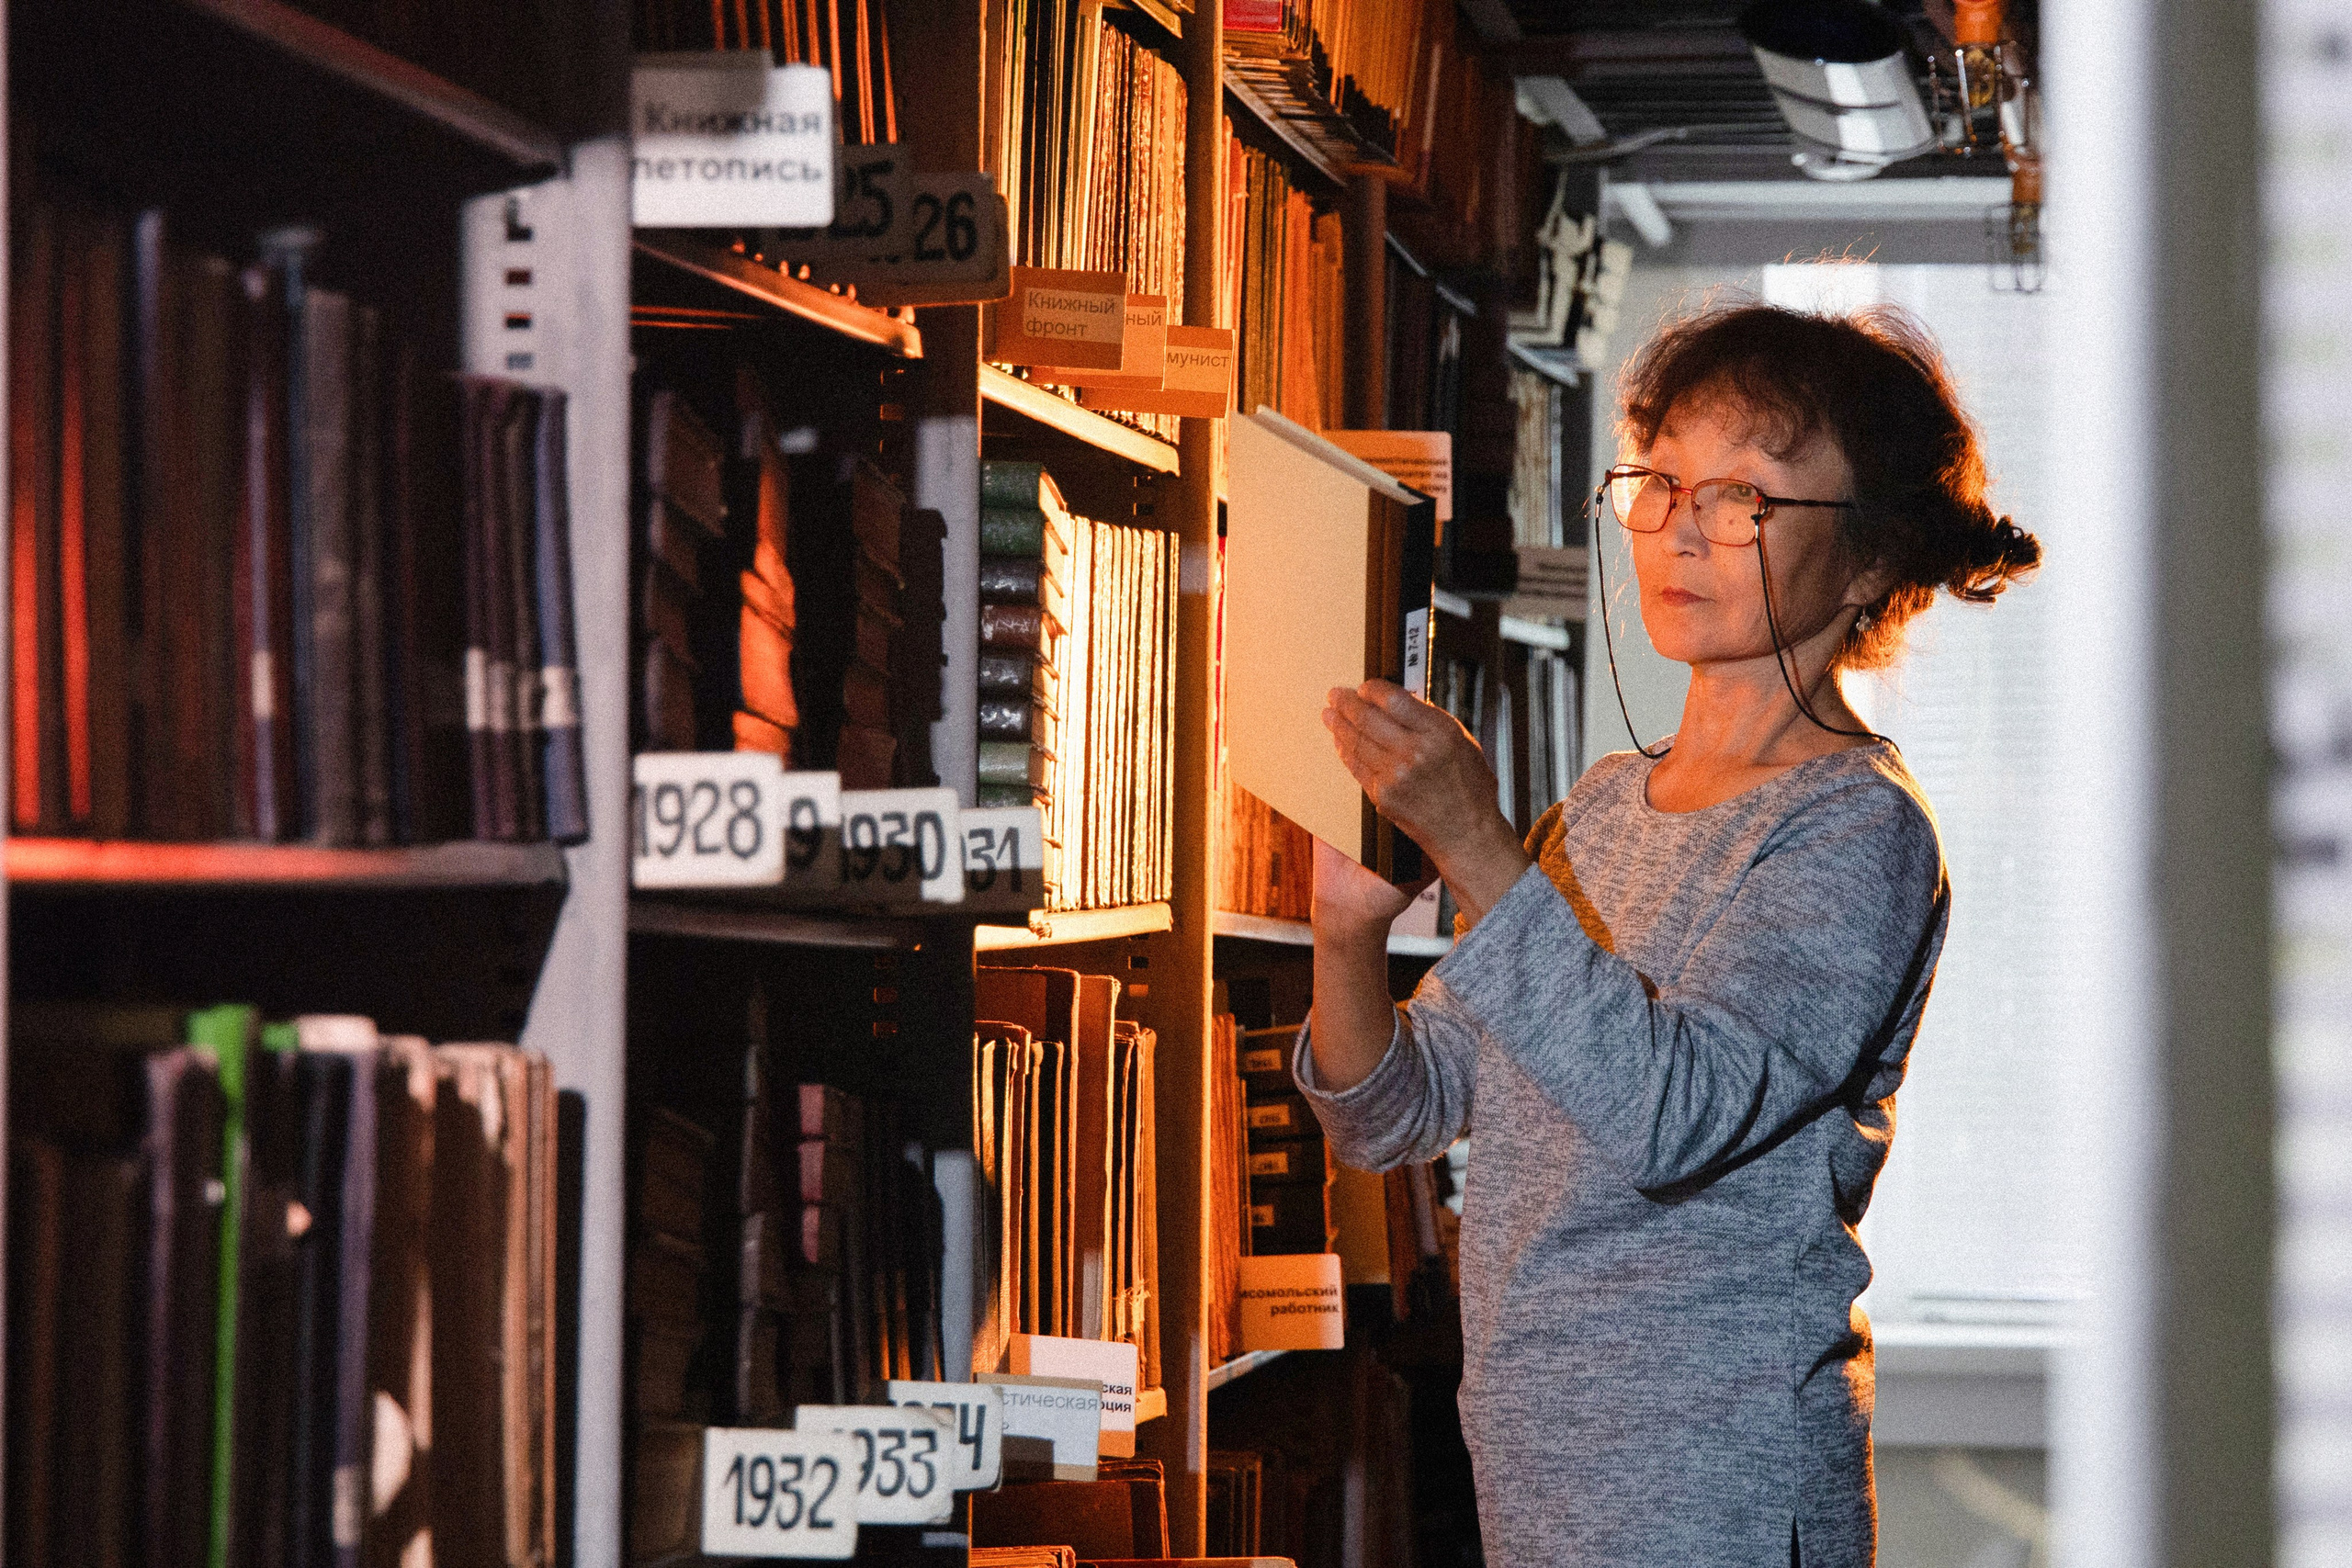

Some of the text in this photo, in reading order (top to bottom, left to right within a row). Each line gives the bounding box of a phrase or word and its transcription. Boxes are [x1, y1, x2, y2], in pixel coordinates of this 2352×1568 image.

[644, 100, 822, 135] Книжная
[1027, 290, 1115, 314] Книжный
[1026, 319, 1089, 336] фронт
[1126, 310, 1163, 326] ный
[1167, 353, 1230, 368] мунист
[640, 779, 763, 860] 1928
[840, 810, 946, 884] 1930
[960, 826, 1023, 893] 31
[1270, 1303, 1340, 1317] работник
[1102, 1383, 1133, 1396] ская
[1002, 1392, 1099, 1412] стическая
[724, 1452, 842, 1530] 1932
